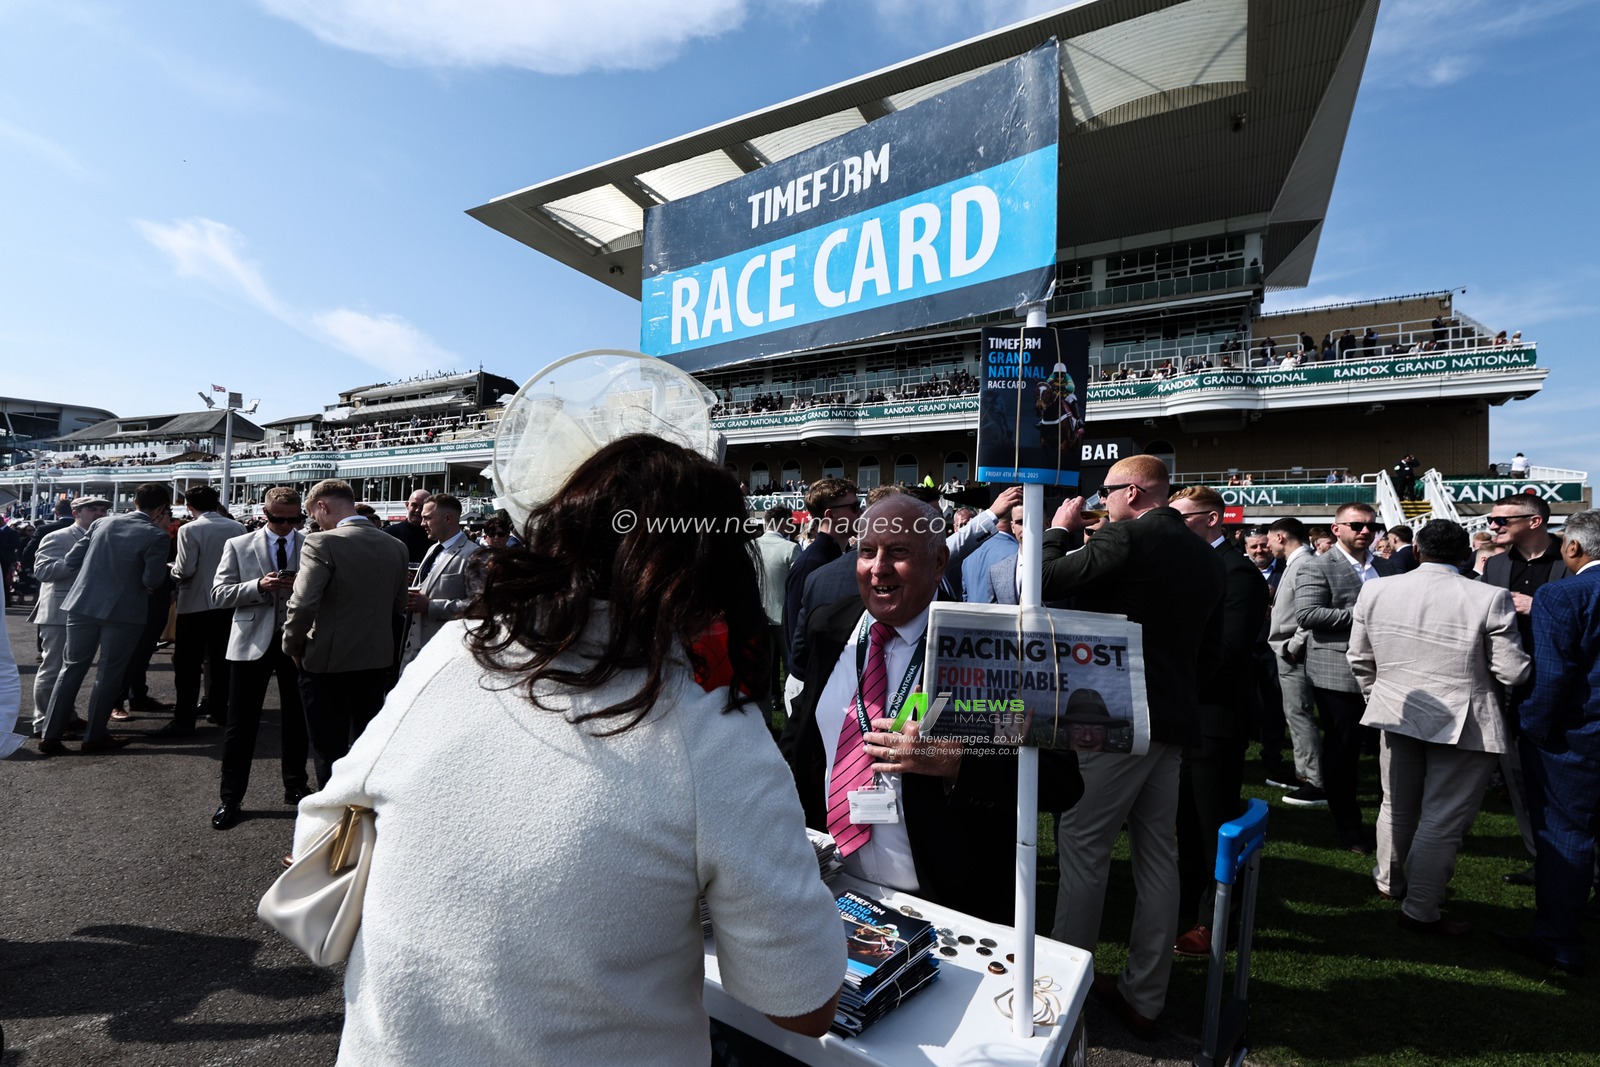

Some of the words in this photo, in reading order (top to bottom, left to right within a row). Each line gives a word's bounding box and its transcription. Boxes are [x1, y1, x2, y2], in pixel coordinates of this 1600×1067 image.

[747, 143, 890, 229] TIMEFORM
[670, 244, 796, 345] RACE
[813, 185, 1001, 308] CARD
[988, 337, 1041, 349] TIMEFRM
[988, 351, 1031, 364] GRAND
[1334, 364, 1389, 378] RANDOX
[1395, 359, 1447, 373] GRAND
[1451, 352, 1530, 368] NATIONAL
[988, 365, 1046, 379] NATIONAL
[988, 380, 1006, 389] RACE
[1158, 377, 1199, 392] RANDOX
[1203, 375, 1244, 385] GRAND
[1247, 372, 1308, 385] NATIONAL
[1086, 387, 1137, 399] NATIONAL
[807, 410, 829, 419] GRAND
[831, 409, 870, 418] NATIONAL
[884, 406, 915, 415] RANDOX
[918, 403, 946, 413] GRAND
[949, 400, 980, 410] NATION
[727, 420, 749, 428] GRAND
[750, 417, 782, 426] NATIONAL
[1081, 443, 1119, 461] BAR
[311, 462, 332, 470] STAND
[1221, 489, 1284, 505] ONAL
[1443, 483, 1564, 502] RANDOX
[938, 635, 1047, 663] RACING
[1057, 641, 1126, 667] POST
[937, 666, 1069, 692] FOURMIDABLE
[838, 896, 872, 915] GRAND
